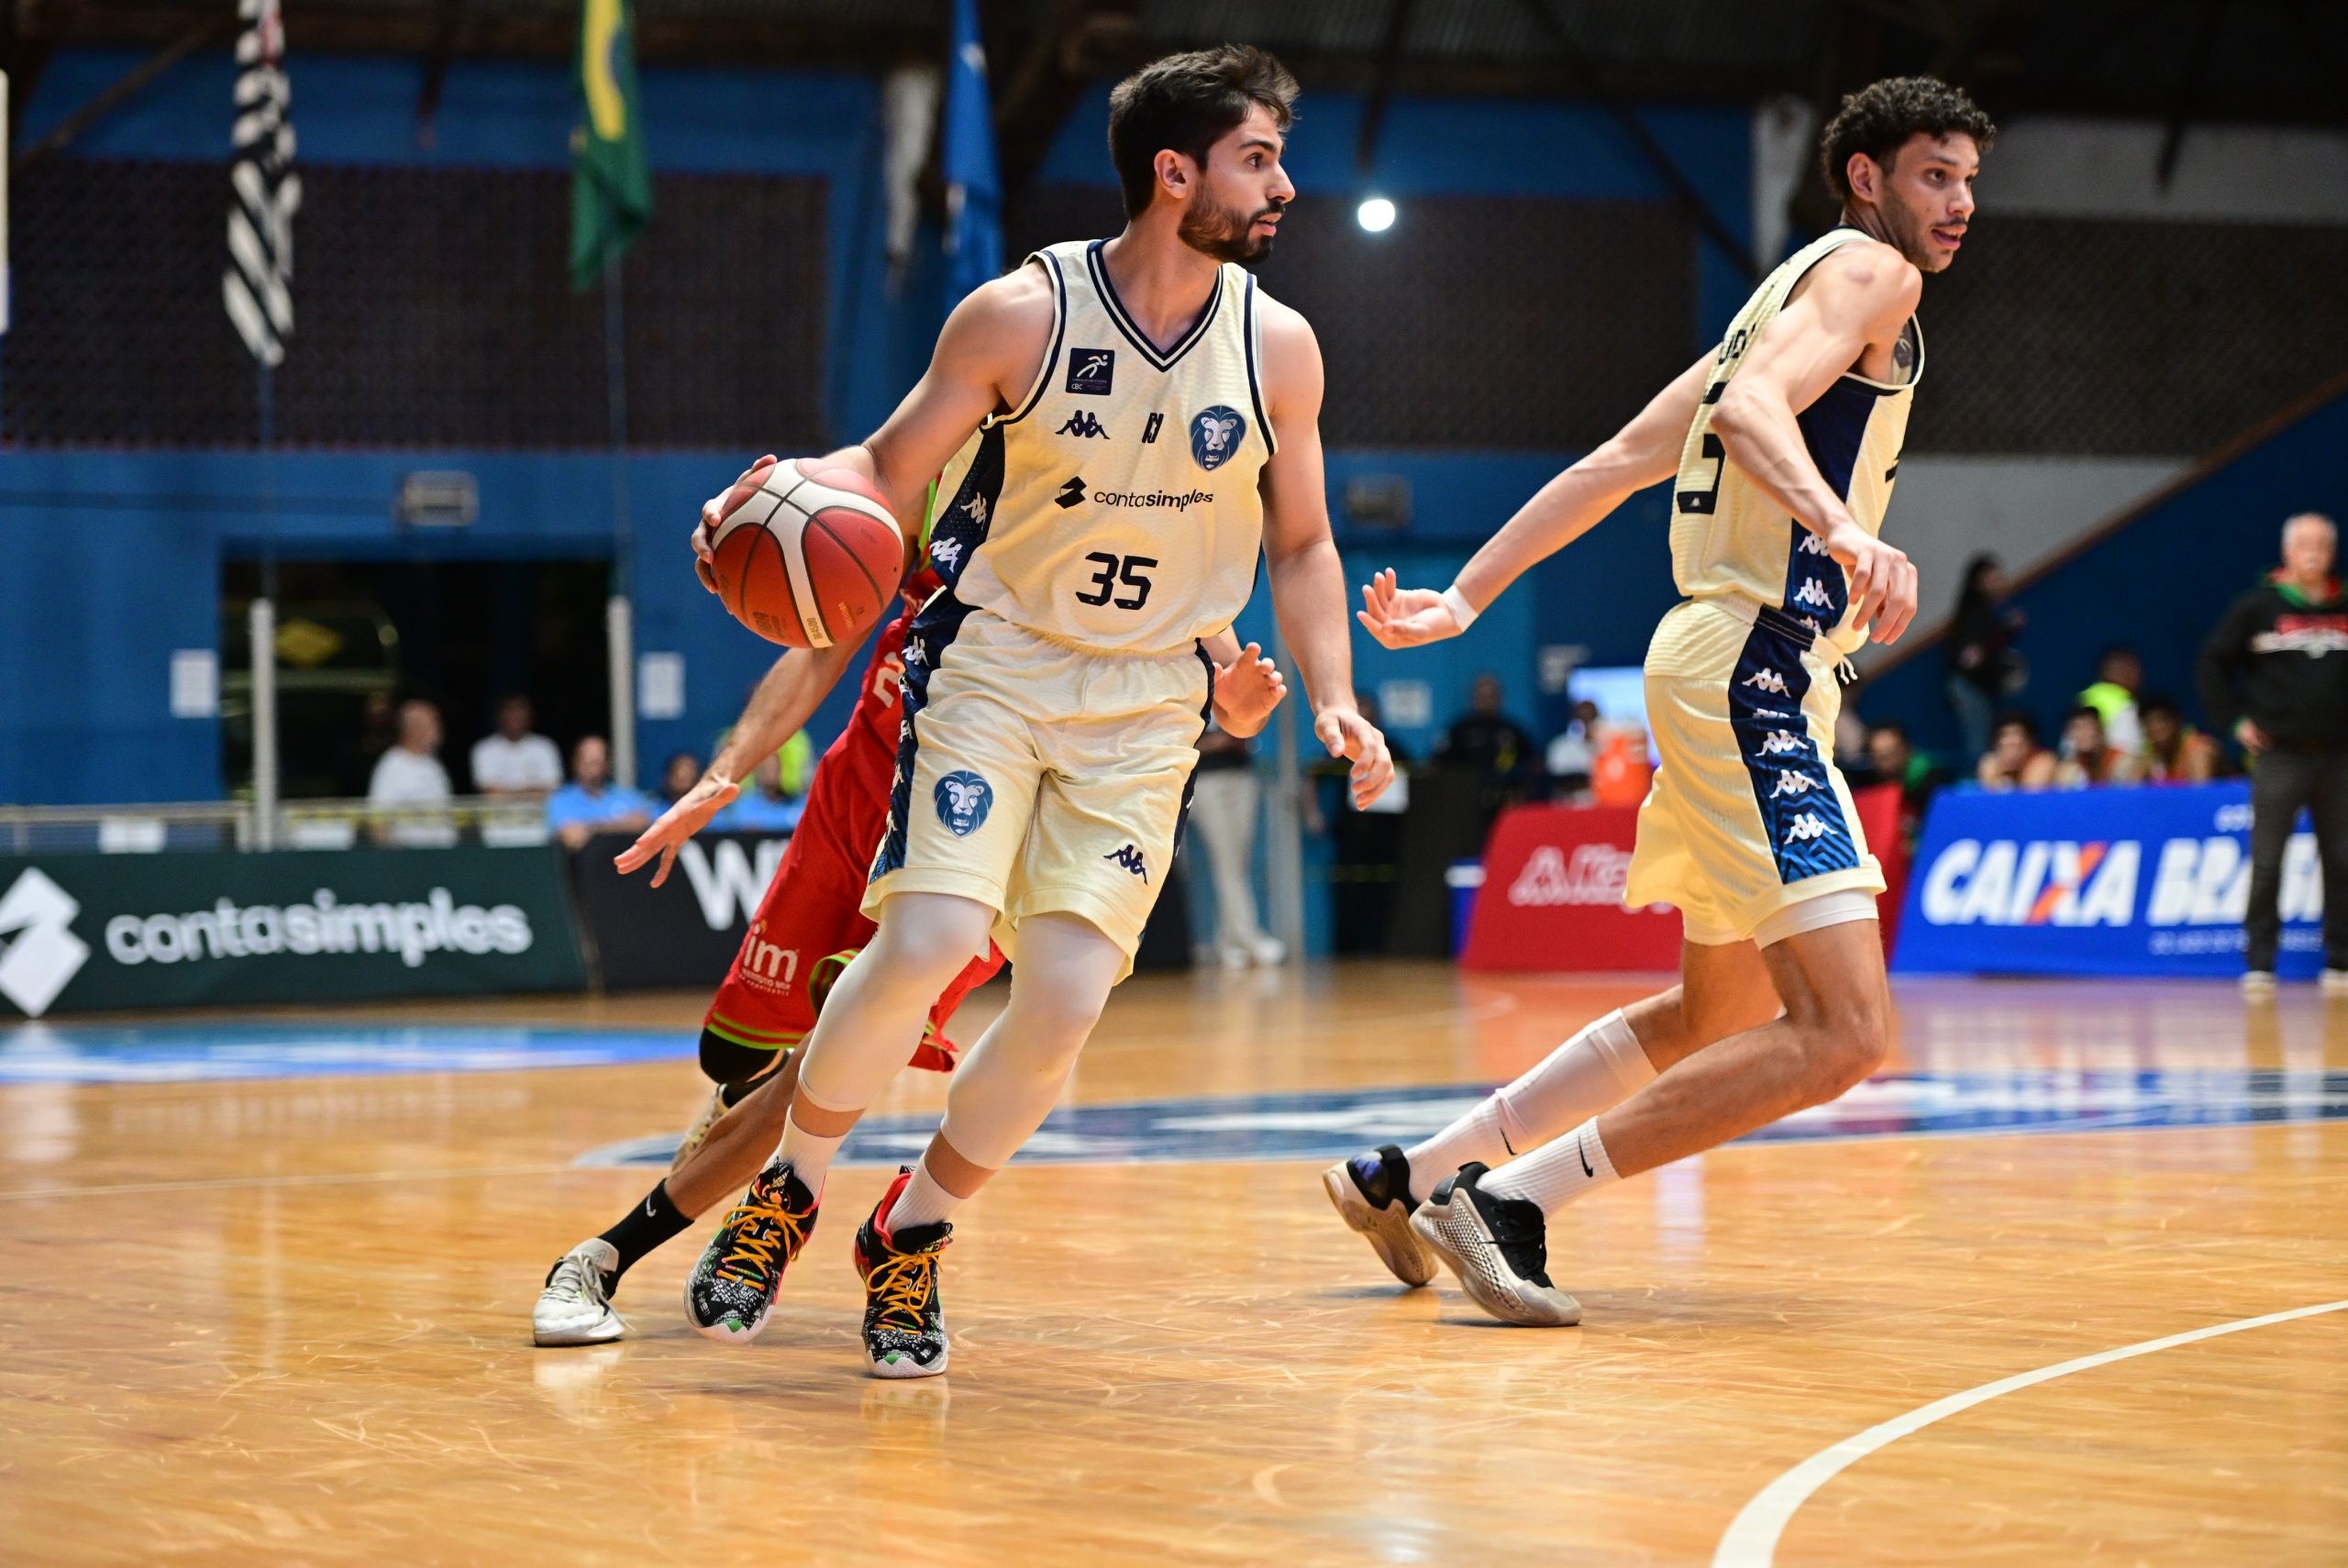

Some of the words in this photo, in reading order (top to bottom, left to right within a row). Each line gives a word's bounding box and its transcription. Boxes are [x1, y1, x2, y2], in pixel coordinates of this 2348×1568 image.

[1094, 489, 1213, 512] contasimples
[1075, 552, 1158, 610] 35
[1921, 838, 2142, 927] CAIXA
[105, 886, 533, 968] contasimples
